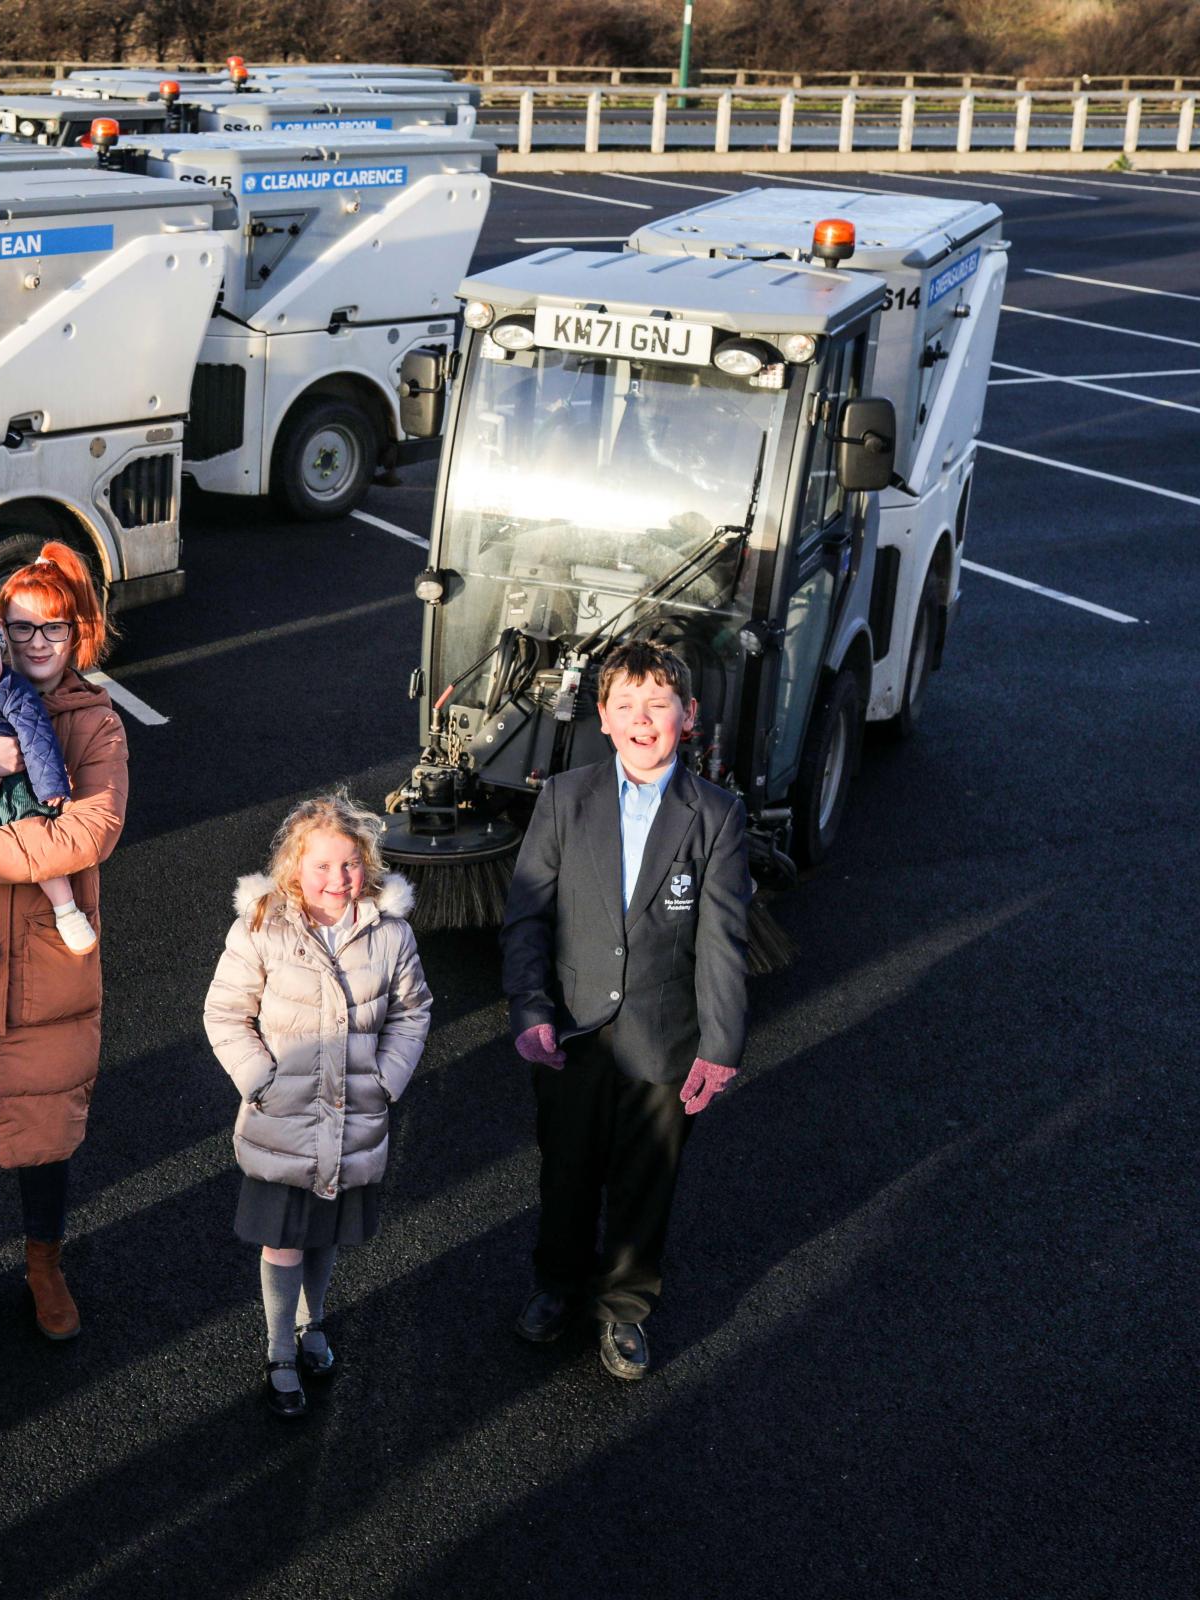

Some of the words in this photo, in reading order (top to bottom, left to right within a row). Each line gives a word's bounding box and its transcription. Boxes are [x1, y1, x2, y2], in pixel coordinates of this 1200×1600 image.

[261, 171, 330, 191] CLEAN-UP
[333, 168, 403, 186] CLARENCE
[554, 314, 621, 349] KM71
[630, 323, 691, 357] GNJ
